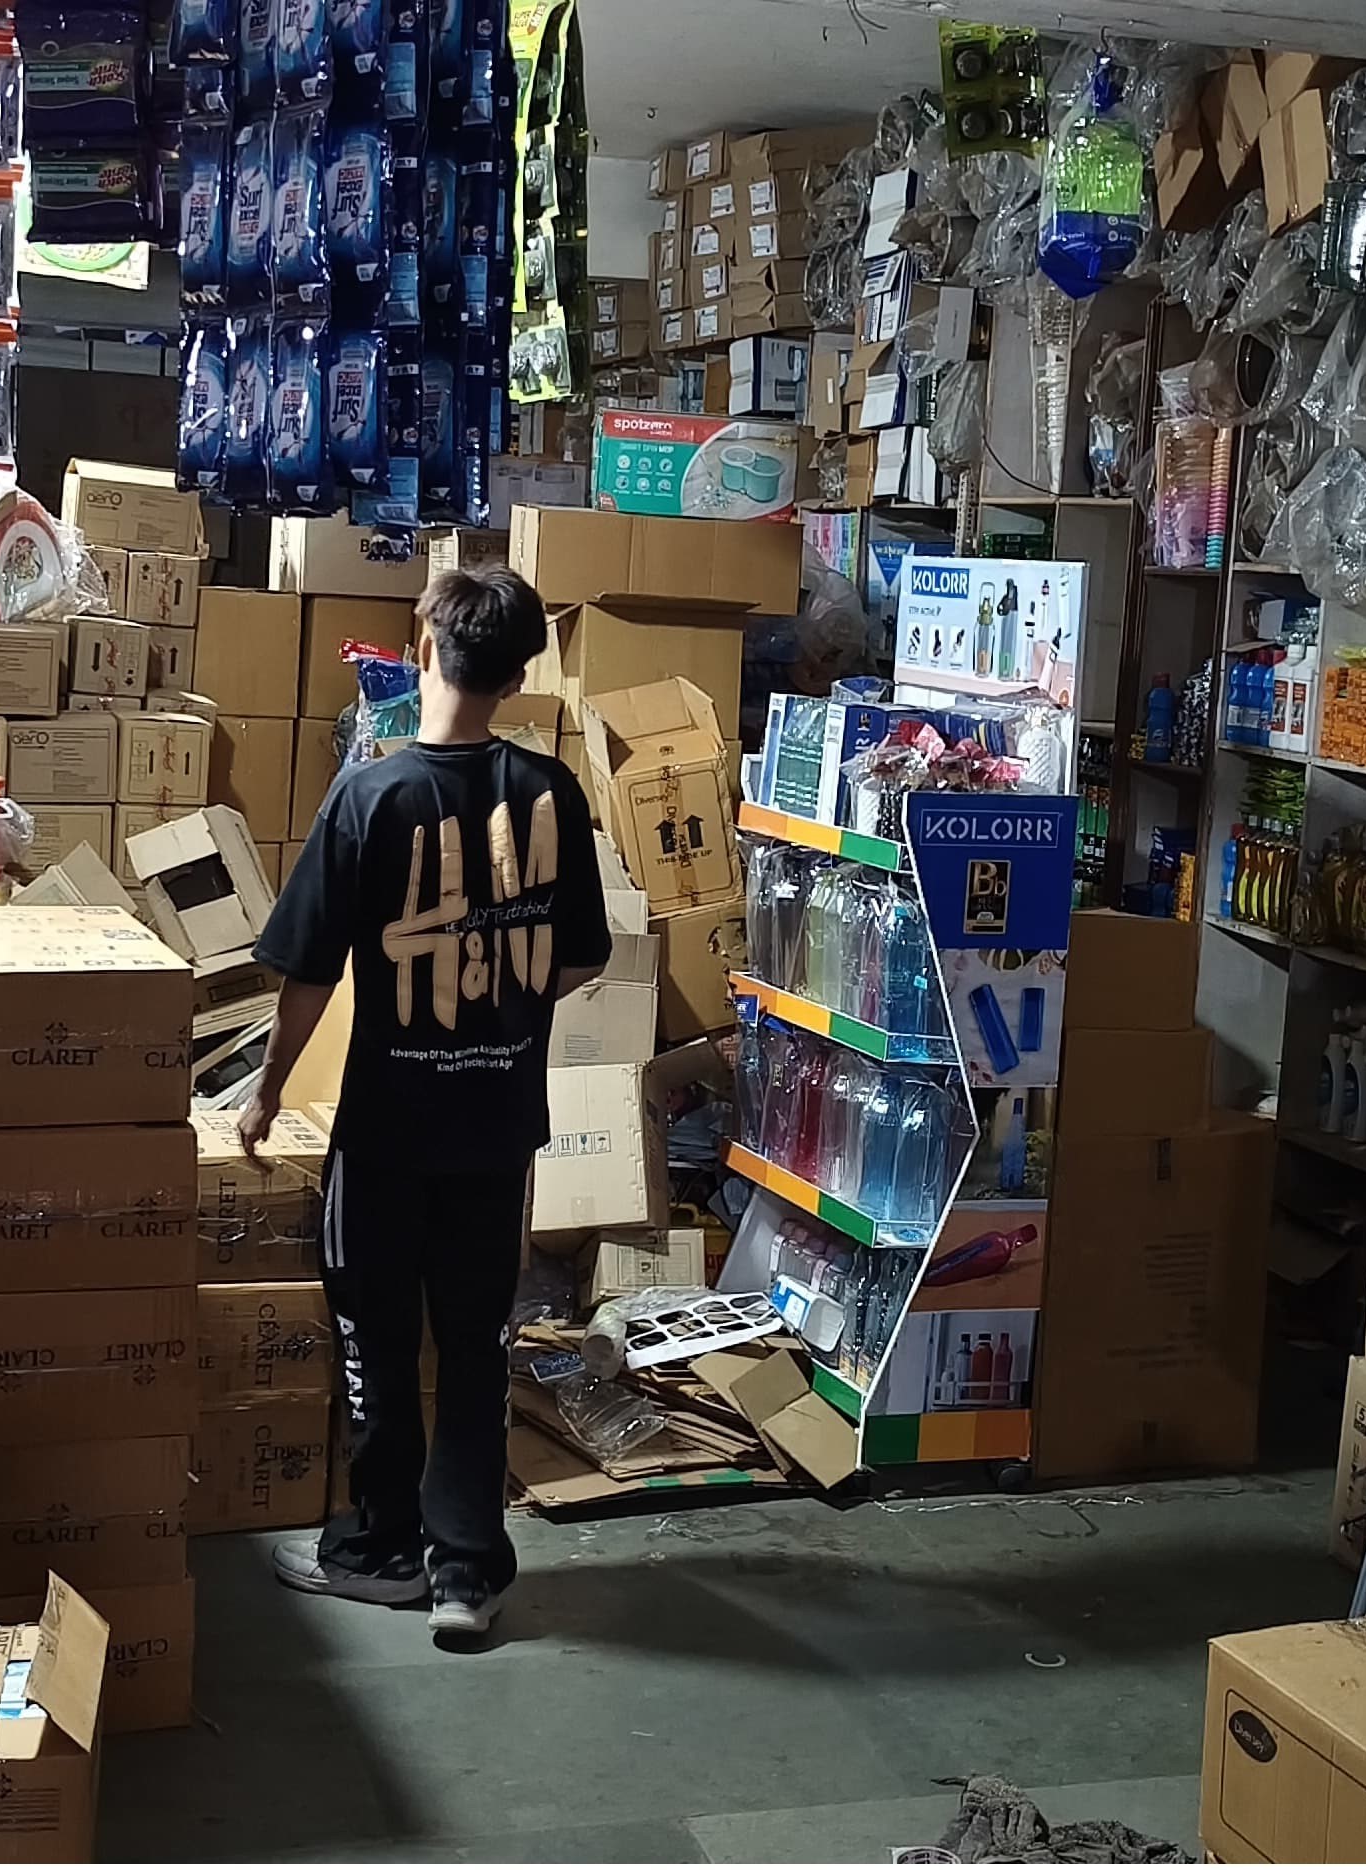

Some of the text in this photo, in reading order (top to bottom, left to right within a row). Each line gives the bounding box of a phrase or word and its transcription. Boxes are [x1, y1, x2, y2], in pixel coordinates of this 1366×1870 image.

[912, 568, 969, 596] KOLORR
[925, 816, 1054, 842] KOLORR
[12, 1049, 100, 1067] CLARET
[390, 1048, 428, 1061] Advantage
[440, 1051, 453, 1059] The
[437, 1063, 454, 1073] Kind
[102, 1221, 188, 1239] CLARET
[104, 1339, 186, 1362] CLARET
[1359, 1407, 1366, 1421] 5
[13, 1526, 100, 1546] CLARET
